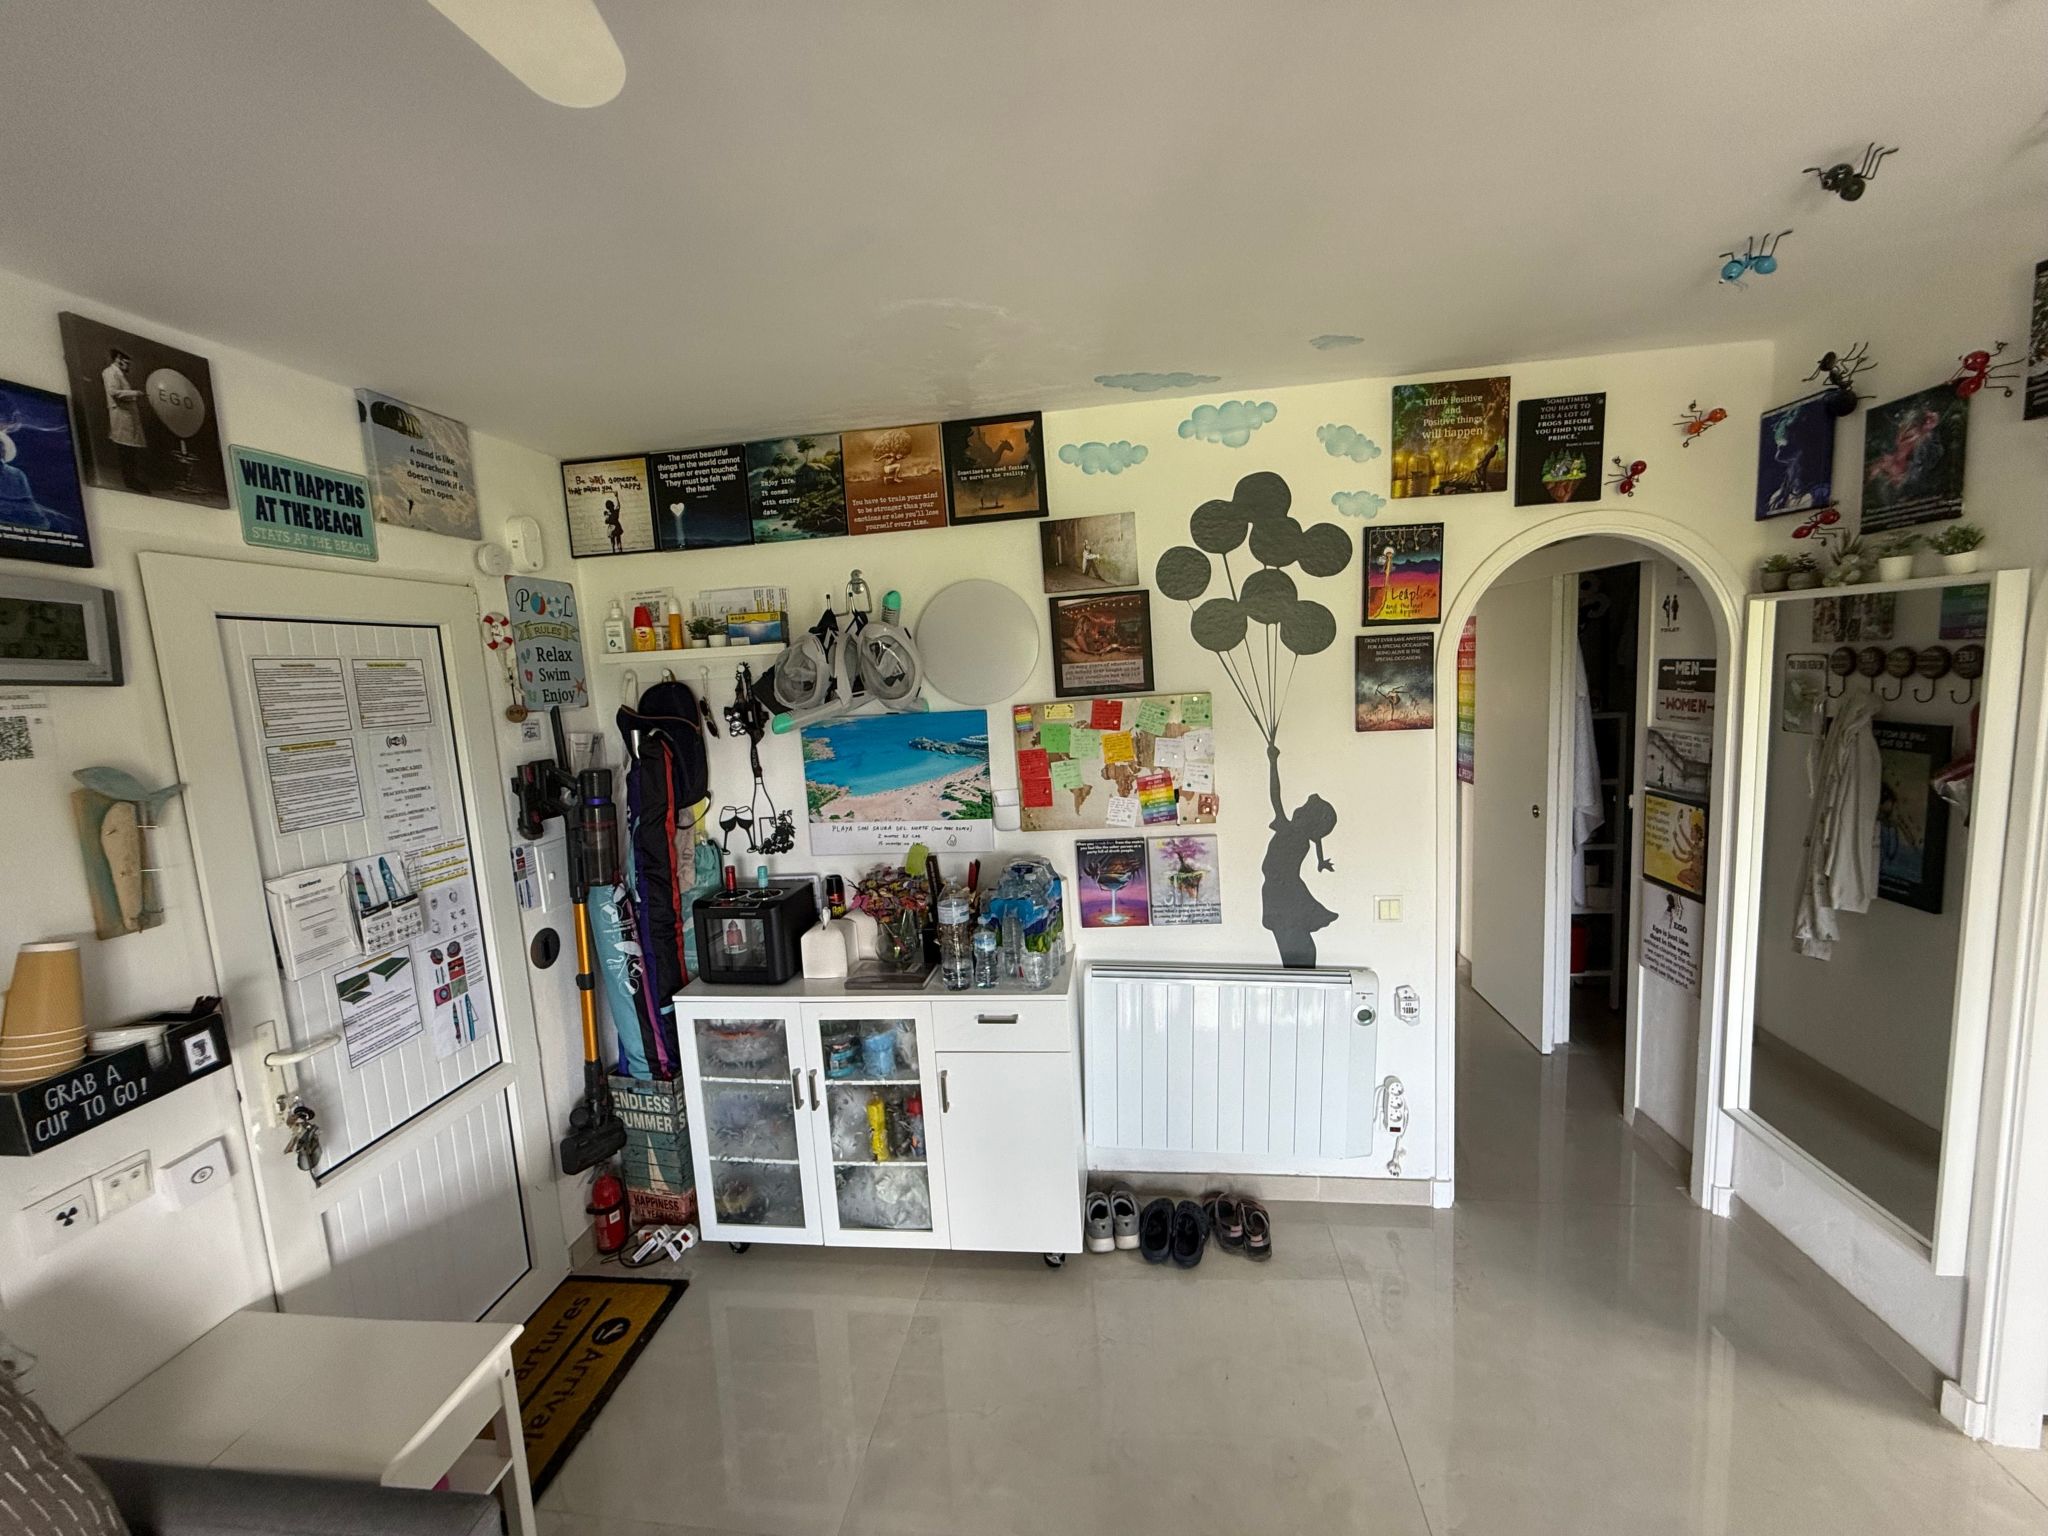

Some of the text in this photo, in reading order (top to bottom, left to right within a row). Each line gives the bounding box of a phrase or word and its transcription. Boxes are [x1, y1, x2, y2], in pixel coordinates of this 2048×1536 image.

[159, 389, 193, 410] EGO
[1424, 394, 1483, 406] Think Positive
[1445, 406, 1461, 414] and
[1424, 416, 1483, 426] Positive things
[1422, 427, 1482, 440] will happen
[416, 449, 434, 460] mind
[442, 455, 455, 466] like
[682, 452, 698, 460] most
[700, 448, 728, 458] beautiful
[657, 463, 678, 471] things
[698, 458, 717, 467] world
[718, 456, 740, 465] cannot
[240, 458, 365, 510] WHAT HAPPENS
[407, 470, 434, 484] doesn't
[434, 479, 452, 488] work
[608, 476, 638, 484] someone
[602, 485, 613, 494] you
[256, 495, 364, 538] AT THE BEACH
[865, 522, 893, 531] yourself
[252, 527, 371, 556] STAYS AT THE BEACH
[534, 625, 560, 635] RULES
[536, 646, 573, 662] Relax
[539, 668, 571, 682] Swim
[1676, 661, 1700, 676] MEN
[542, 688, 575, 704] Enjoy
[1666, 697, 1707, 714] WOMEN
[1653, 924, 1662, 934] Ego
[1674, 922, 1687, 934] EGO
[44, 1064, 122, 1111] GRAB A
[36, 1077, 148, 1141] CUP TO GO!
[612, 1091, 671, 1114] ENDLESS
[616, 1110, 673, 1132] SUMMER
[634, 1195, 679, 1212] HAPPINESS
[516, 1296, 590, 1380] artures
[524, 1348, 603, 1448] Arrival
